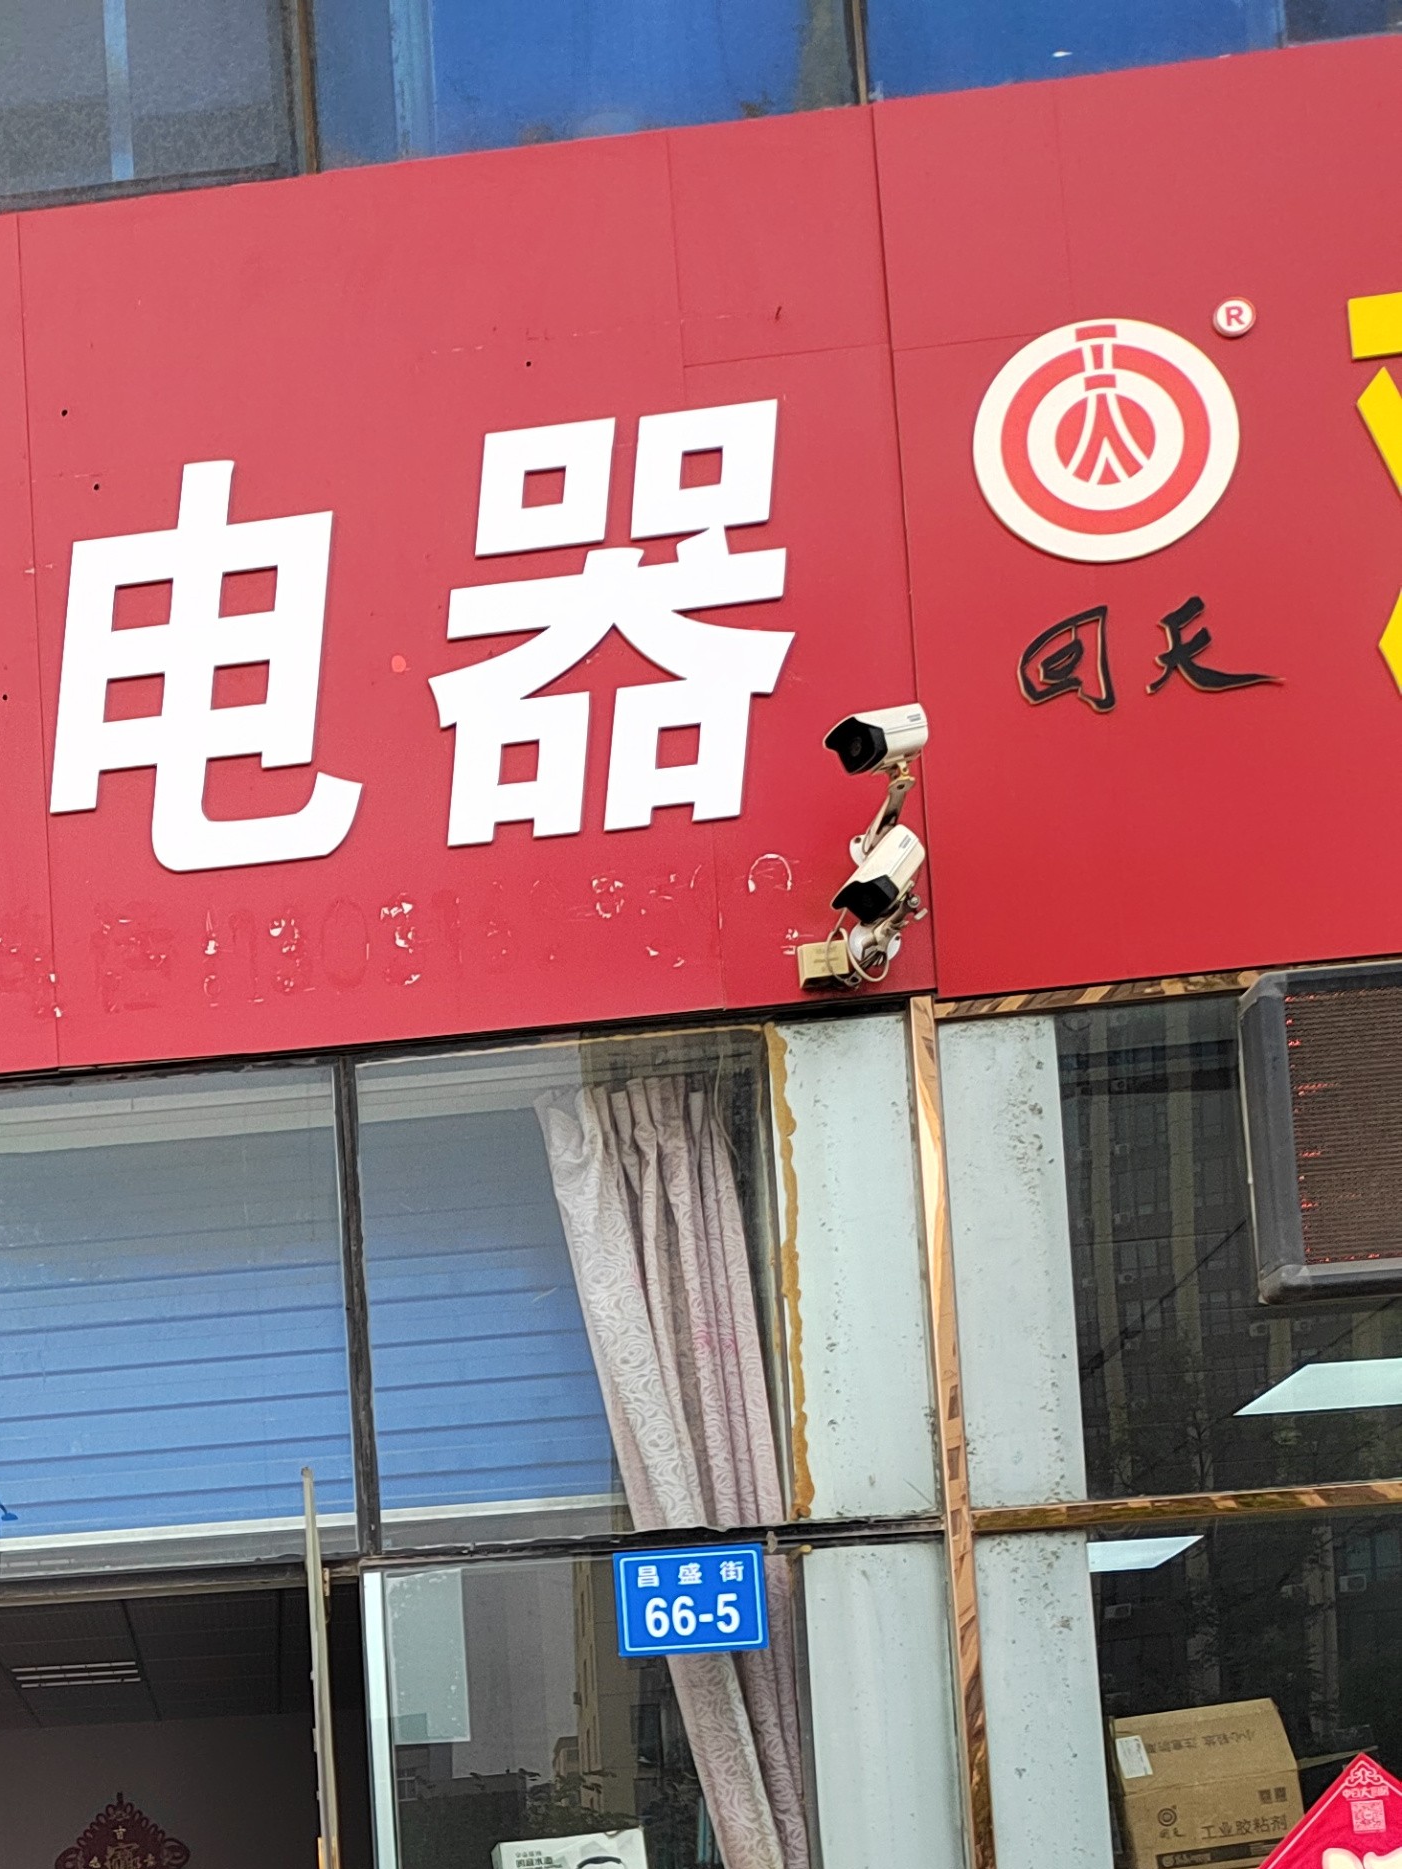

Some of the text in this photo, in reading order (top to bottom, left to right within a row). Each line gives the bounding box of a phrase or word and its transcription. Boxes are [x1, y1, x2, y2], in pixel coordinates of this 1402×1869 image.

[49, 398, 796, 872] 电器
[1017, 596, 1286, 713] 回天
[637, 1560, 744, 1588] 昌盛街
[645, 1593, 740, 1638] 66-5
[1200, 1814, 1289, 1840] 工业胶粘剂
